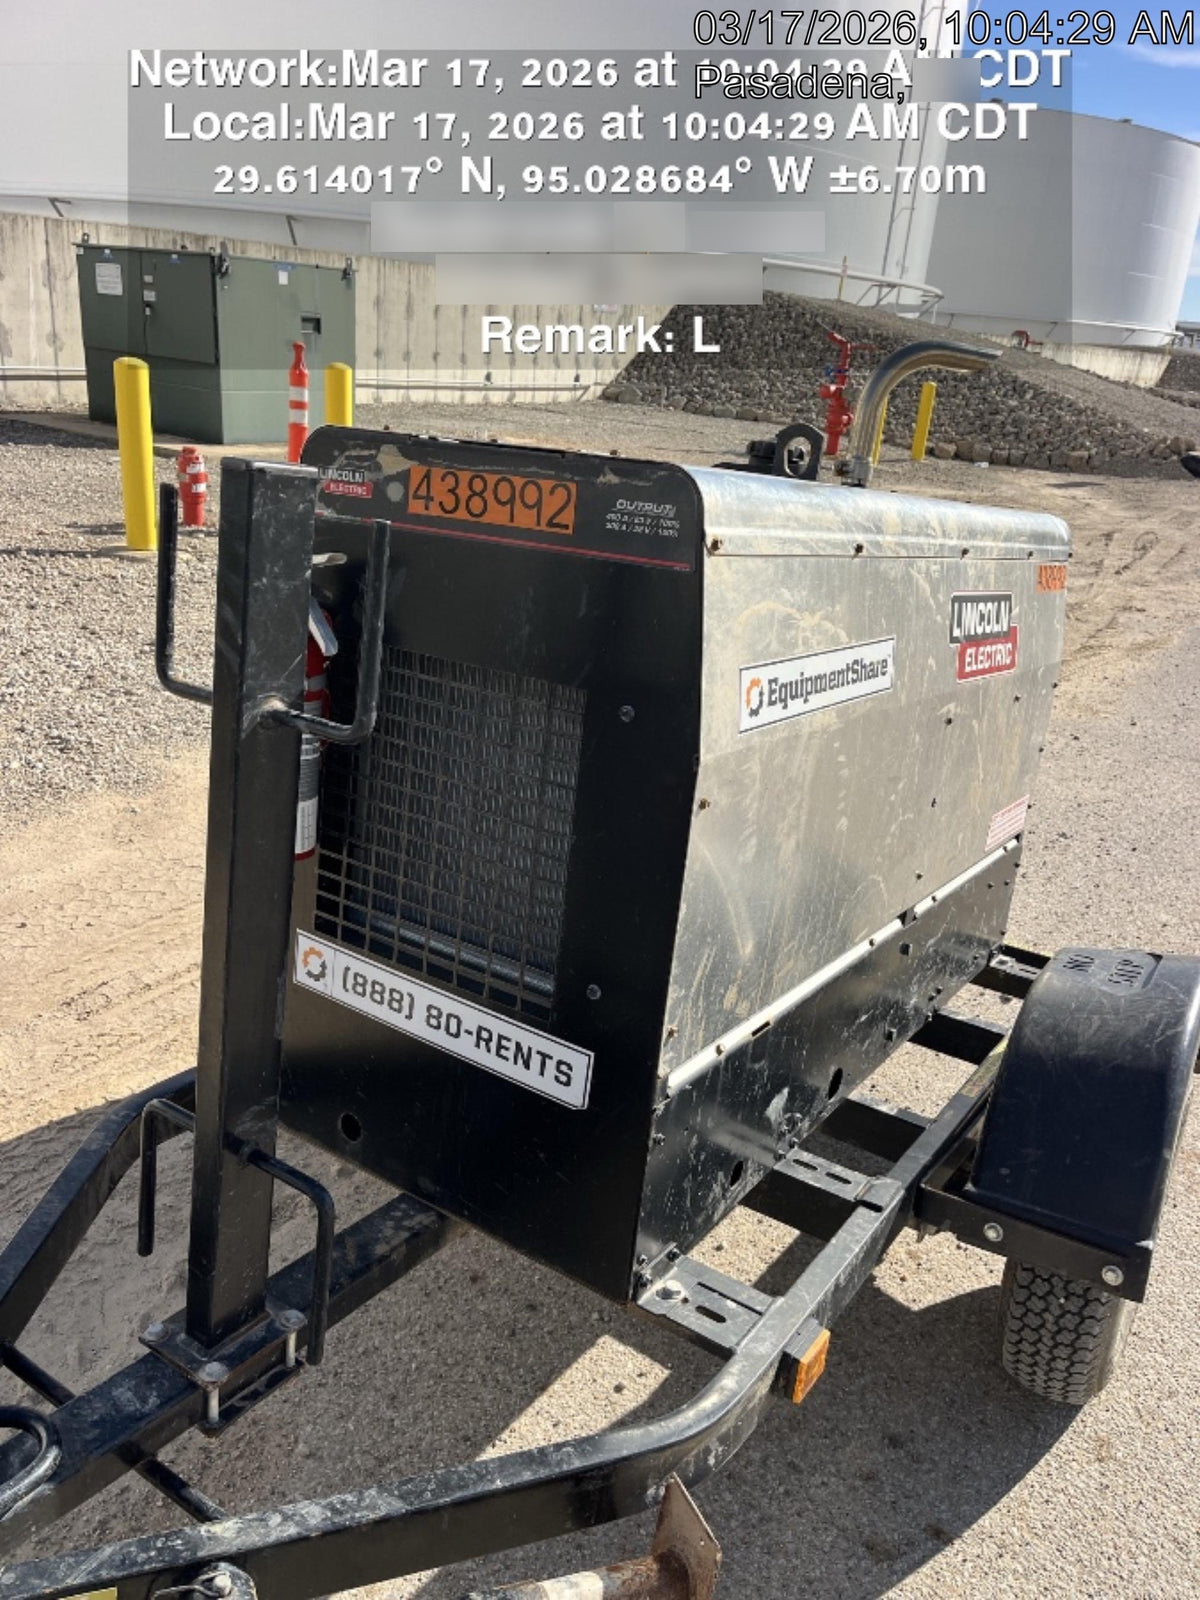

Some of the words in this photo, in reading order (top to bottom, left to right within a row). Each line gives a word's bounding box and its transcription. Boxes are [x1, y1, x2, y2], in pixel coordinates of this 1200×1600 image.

[319, 467, 365, 484] LINCOLN
[411, 467, 576, 532] 438992
[616, 499, 674, 515] OUTPUT
[953, 601, 1010, 637] LINCOLN
[964, 642, 1013, 673] ELECTRIC
[766, 657, 889, 711] EquipmentShare
[341, 965, 416, 1021] (888)
[425, 1002, 575, 1089] 80-RENTS
